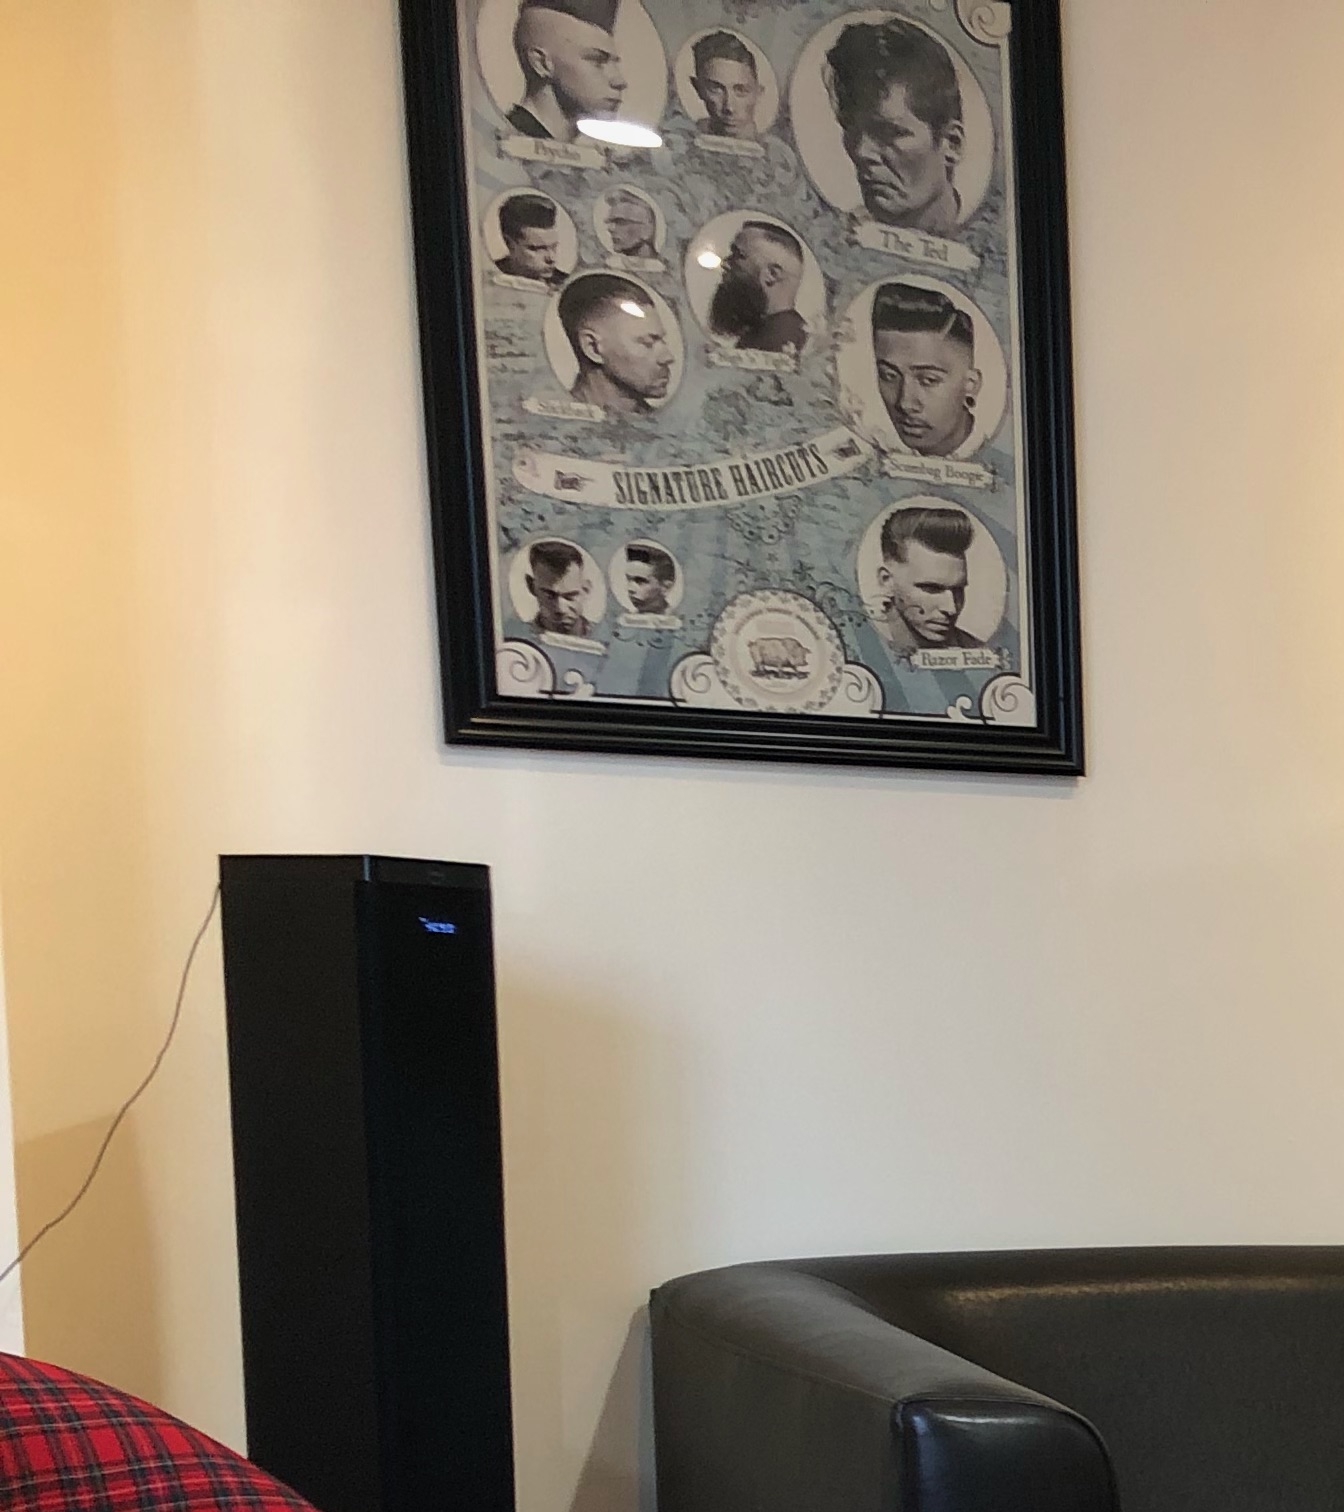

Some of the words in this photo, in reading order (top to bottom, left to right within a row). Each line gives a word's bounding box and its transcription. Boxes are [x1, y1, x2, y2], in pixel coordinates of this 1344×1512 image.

[880, 229, 914, 253] The
[919, 238, 949, 262] Ted
[612, 467, 728, 505] SIGNATURE
[729, 443, 830, 497] HAIRCUTS
[921, 652, 958, 667] Razor
[962, 652, 992, 667] Fade
